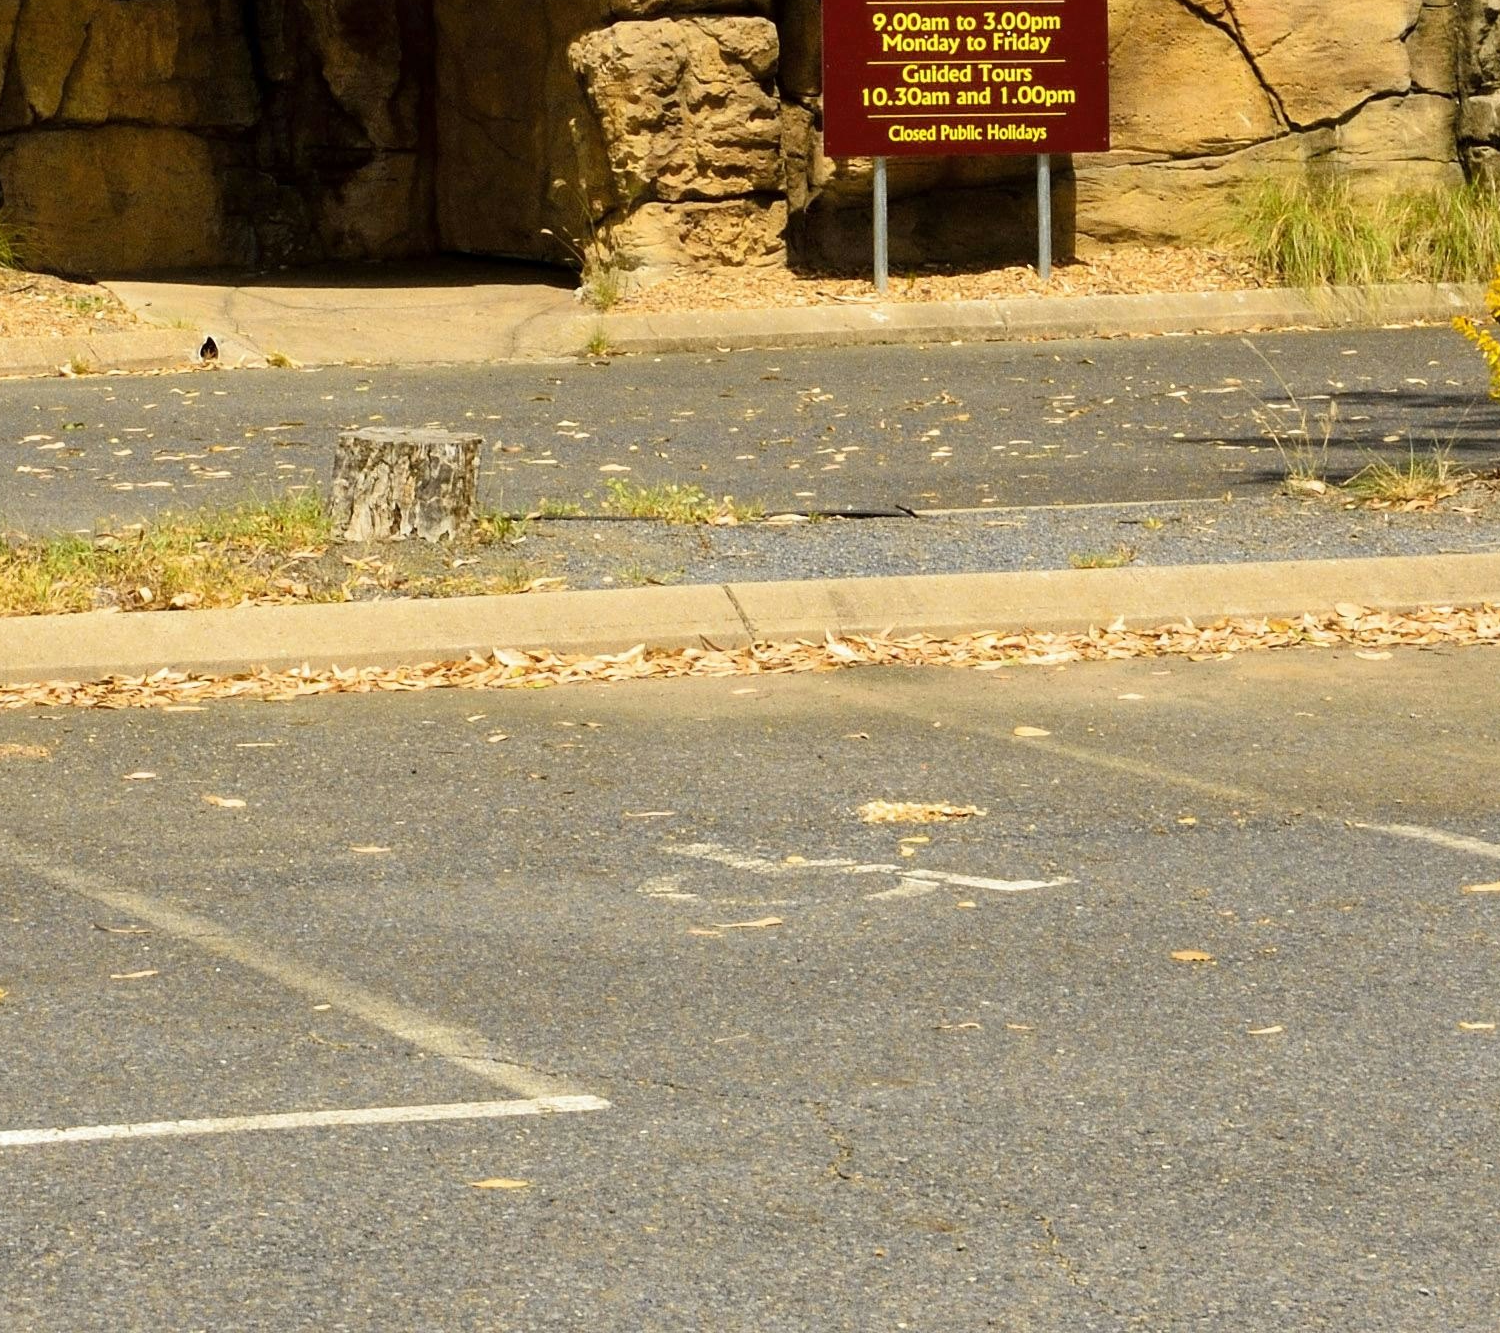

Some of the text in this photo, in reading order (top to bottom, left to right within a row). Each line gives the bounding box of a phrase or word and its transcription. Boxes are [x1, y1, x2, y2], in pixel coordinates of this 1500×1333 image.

[872, 11, 1061, 33] 9.00am to 3.00pm
[882, 32, 1052, 55] Monday to Friday
[902, 64, 1033, 83] Guided Tours
[862, 85, 1076, 107] 10.30am and 1.00pm
[888, 123, 1047, 143] Closed Public Holidays
